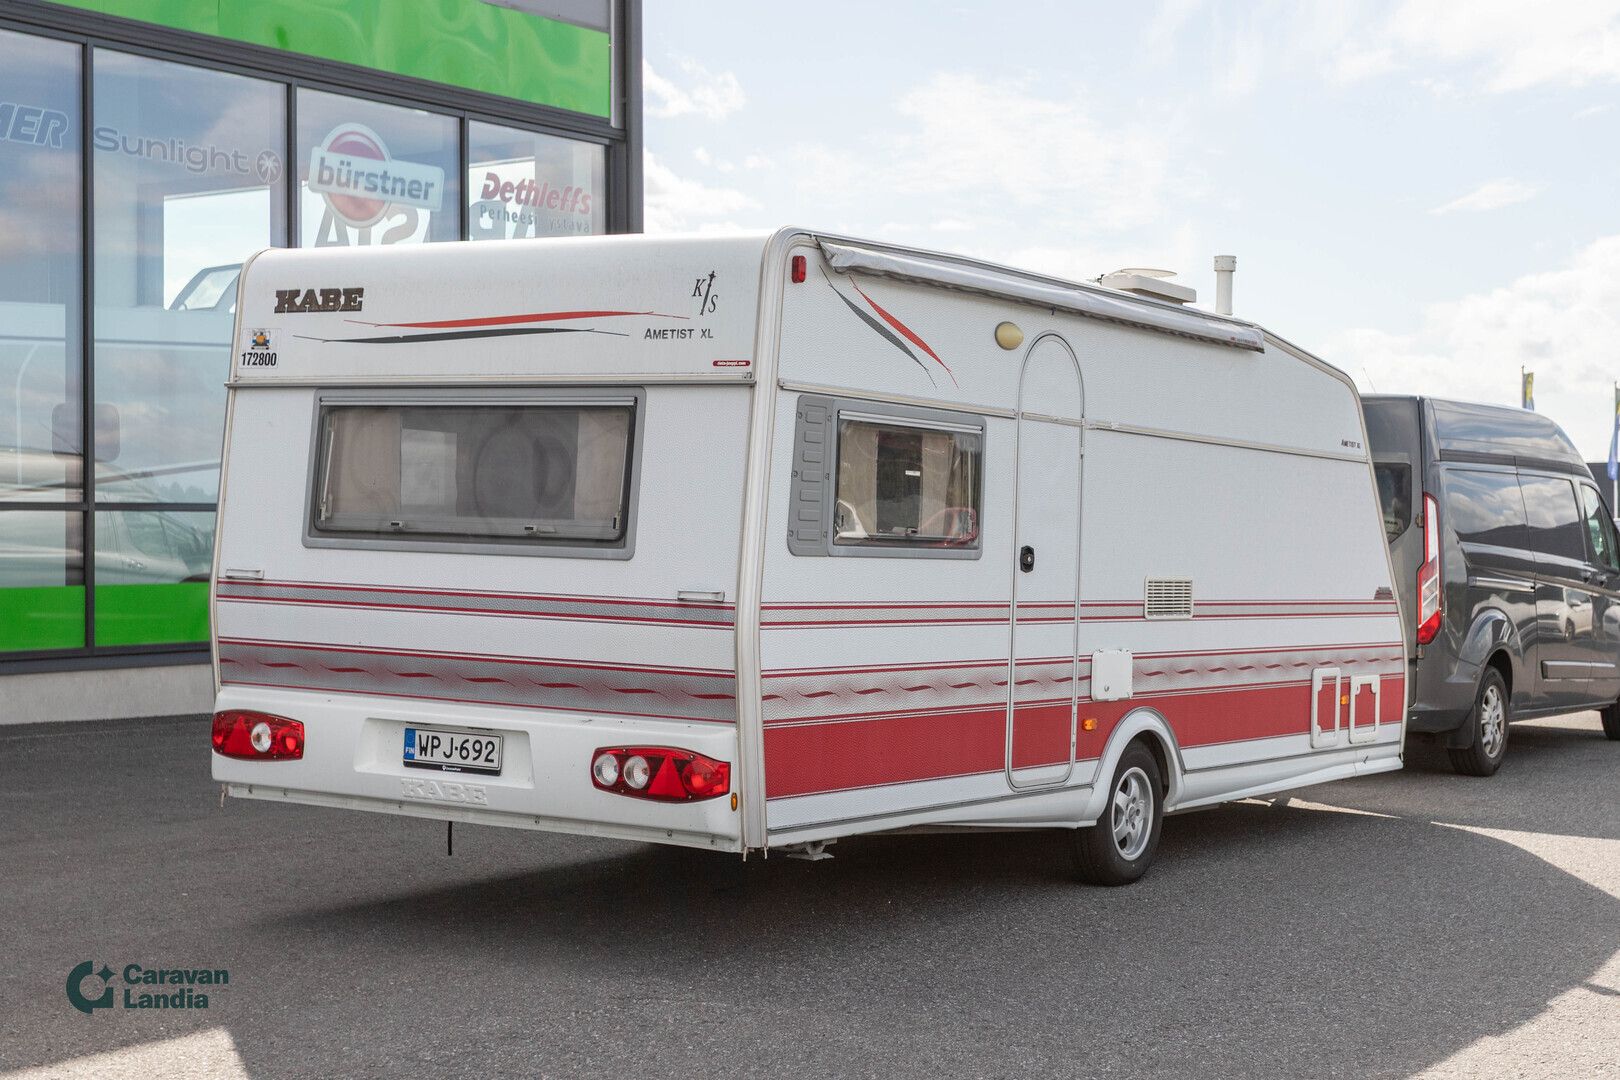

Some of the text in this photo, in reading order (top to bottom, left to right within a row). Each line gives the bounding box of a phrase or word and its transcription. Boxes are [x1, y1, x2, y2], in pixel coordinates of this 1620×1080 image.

[93, 126, 250, 174] Sunlight
[317, 157, 434, 201] bürstner
[480, 172, 591, 215] Dethleffs
[274, 288, 364, 314] KABE
[644, 328, 714, 340] AMETIST XL
[242, 352, 277, 366] 172800
[418, 734, 495, 763] WPJ-692
[401, 777, 488, 806] KABE
